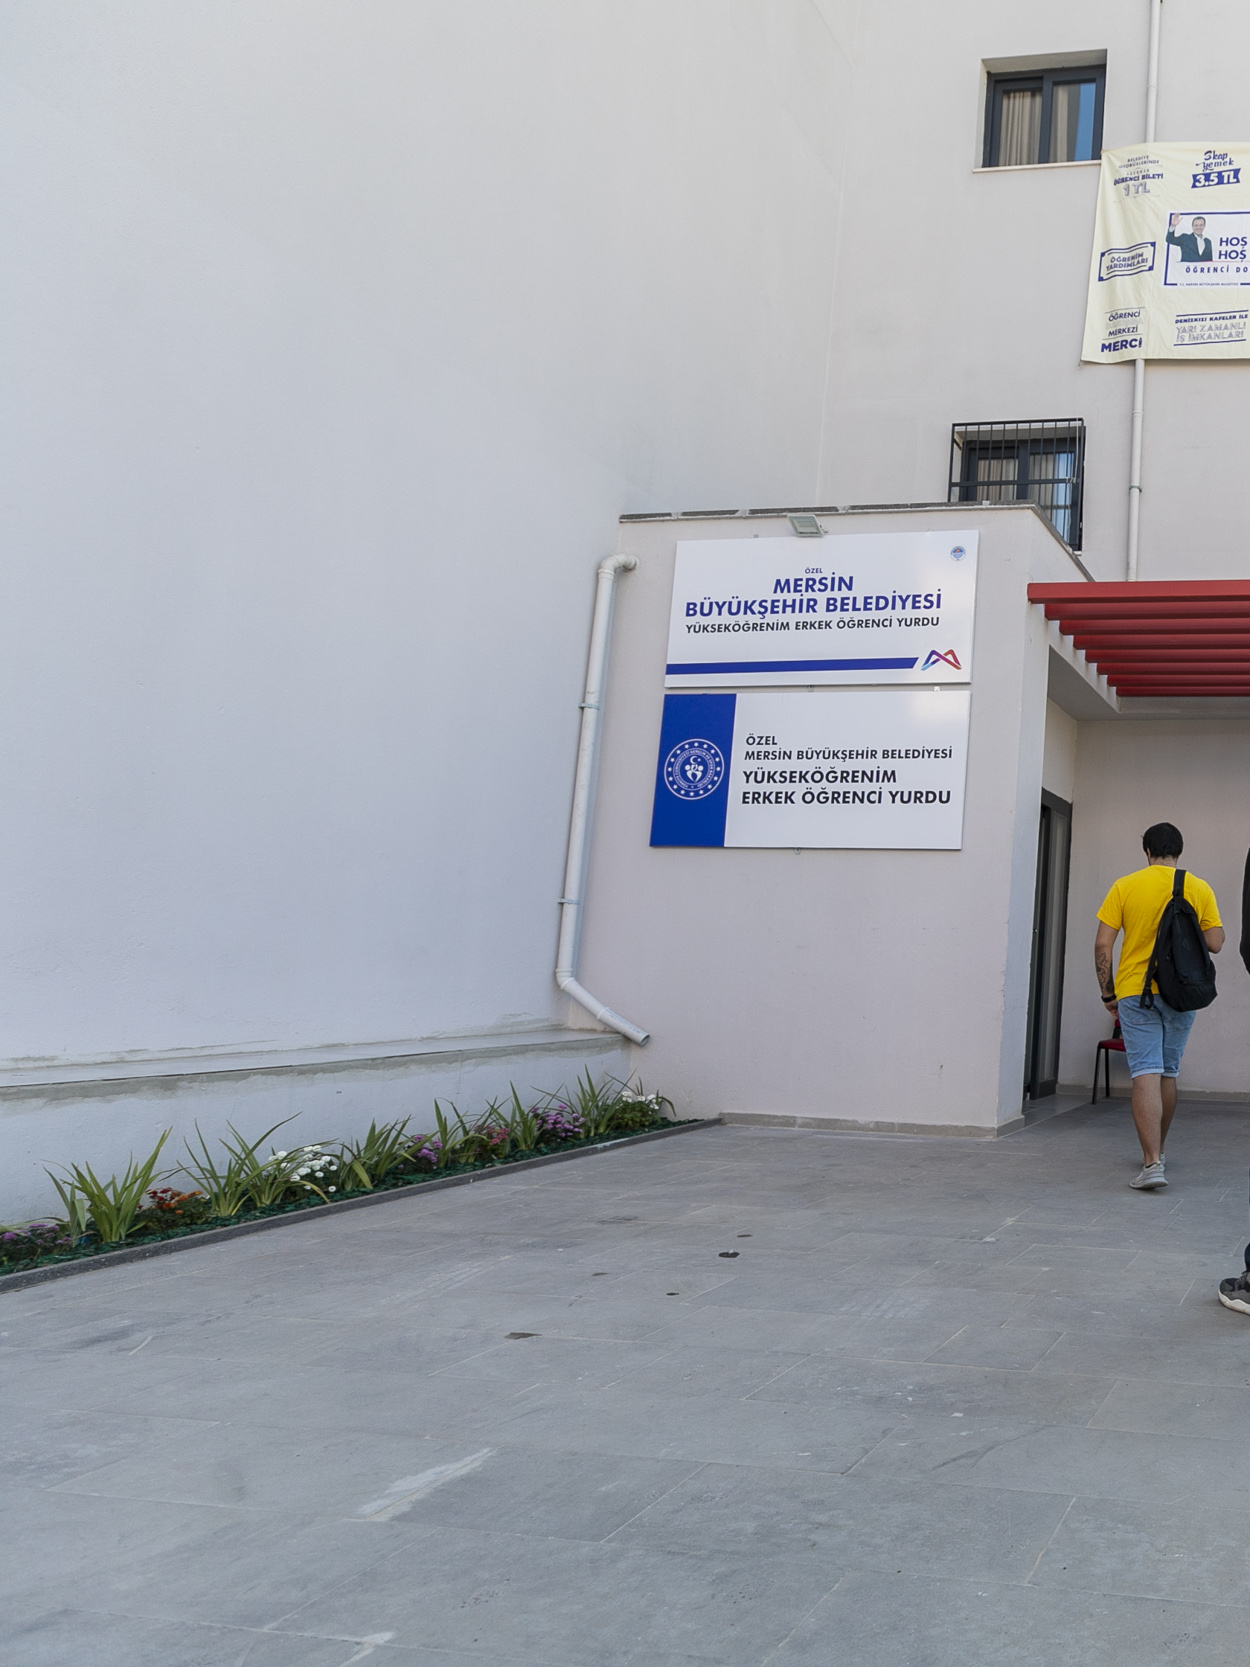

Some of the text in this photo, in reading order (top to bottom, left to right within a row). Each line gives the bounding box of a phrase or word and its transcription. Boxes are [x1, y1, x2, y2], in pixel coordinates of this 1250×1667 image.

[1212, 150, 1228, 161] kap
[1200, 157, 1234, 172] yemek
[1114, 175, 1140, 186] ÖĞRENCİ
[1141, 172, 1163, 180] BİLETİ
[1195, 170, 1237, 187] 3.5 TL
[1123, 181, 1150, 196] 1 TL
[1219, 237, 1248, 249] HOŞ
[1218, 250, 1246, 262] HOŞ
[1186, 266, 1229, 274] ÖĞRENCİ
[1108, 309, 1141, 322] ÖĞRENCİ
[1108, 324, 1138, 337] MERKEZİ
[1176, 322, 1246, 334] YARI ZAMANLI
[773, 572, 854, 594] MERSİN
[685, 589, 942, 619] BÜYÜKŞEHİR BELEDİYESİ
[685, 615, 940, 634] YÜKSEKÖĞRENİM ERKEK ÖĞRENCİ YURDU
[745, 733, 778, 746] ÖZEL
[744, 745, 952, 763] MERSİN BÜYÜKŞEHİR BELEDİYESİ
[742, 766, 897, 784] YÜKSEKÖĞRENİM
[742, 787, 951, 805] ERKEK ÖĞRENCİ YURDU
